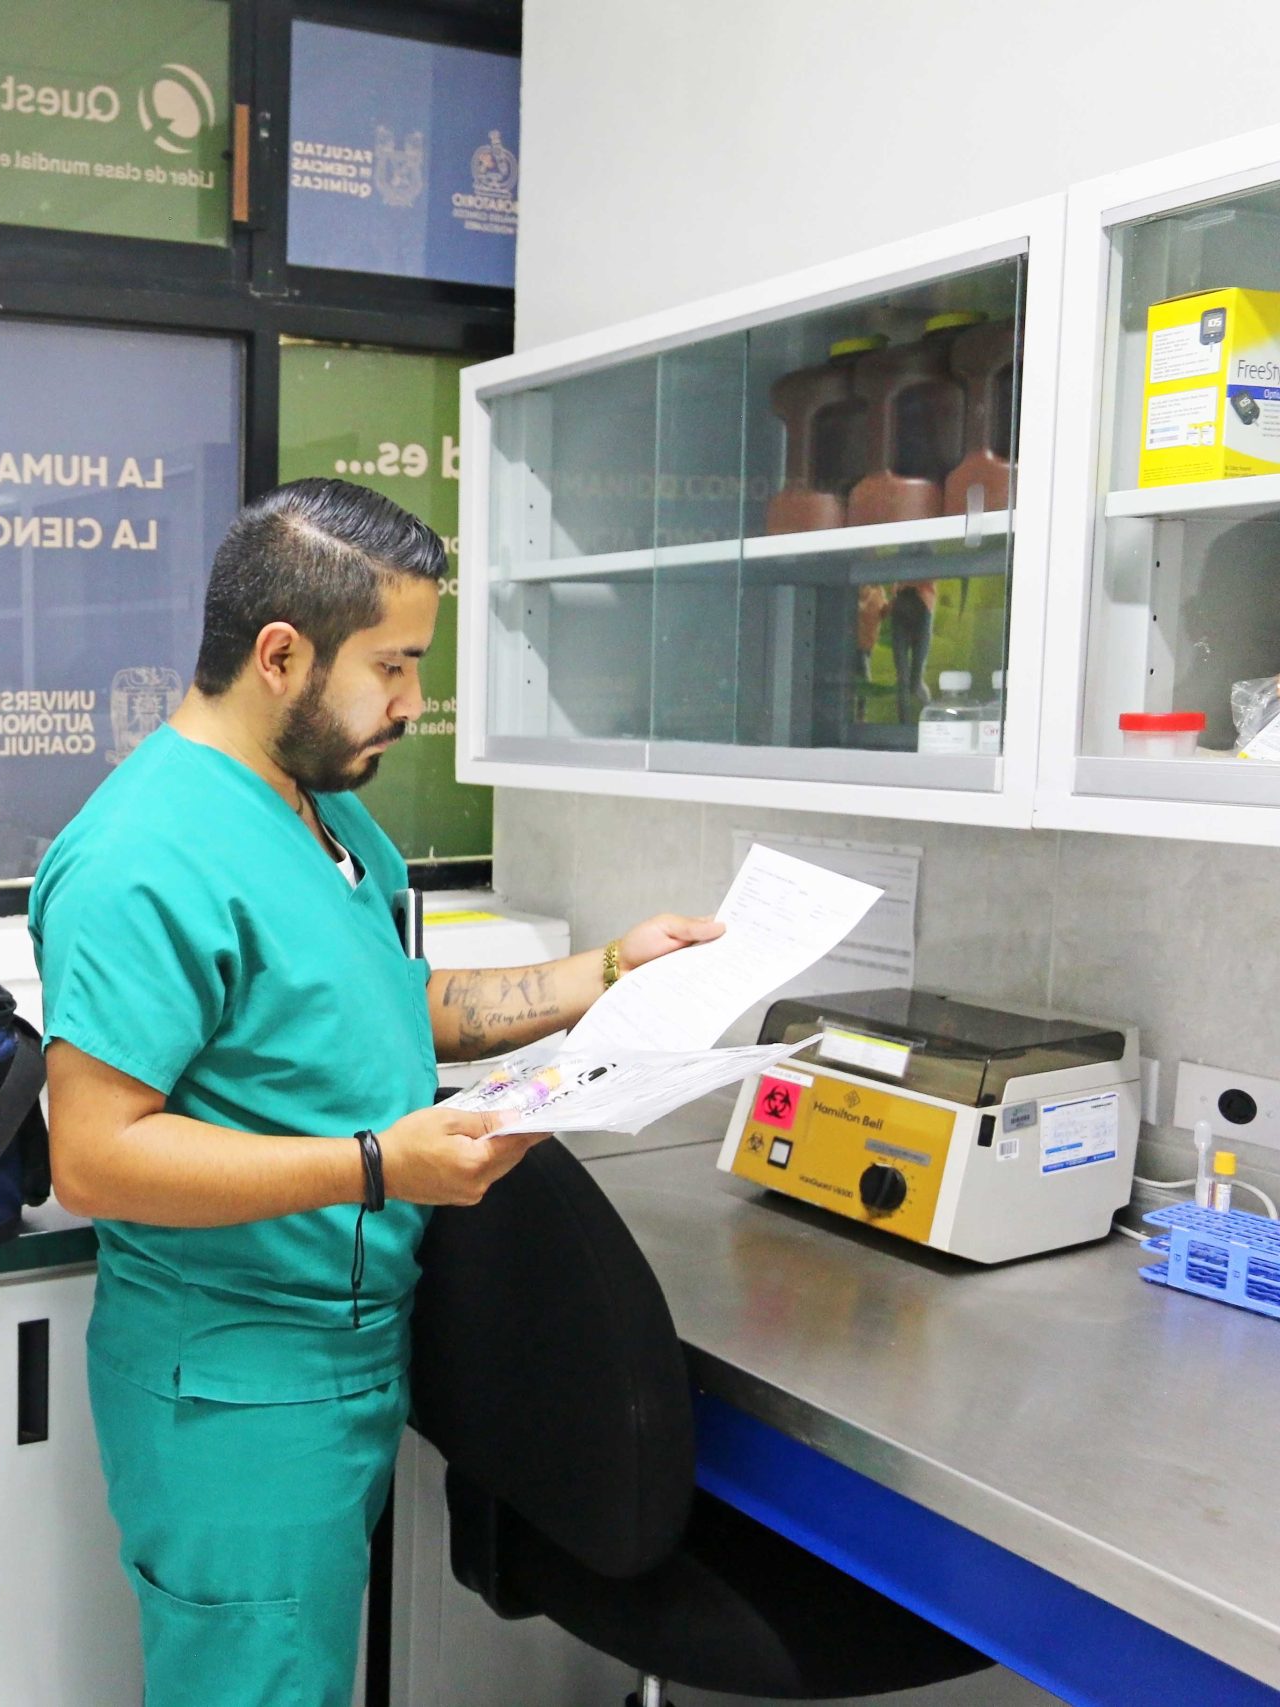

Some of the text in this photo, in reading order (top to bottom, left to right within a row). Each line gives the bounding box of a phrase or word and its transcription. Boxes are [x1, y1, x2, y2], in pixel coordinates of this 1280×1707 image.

[1236, 359, 1280, 385] FreeSt
[813, 1101, 885, 1132] Hamilton Bell
